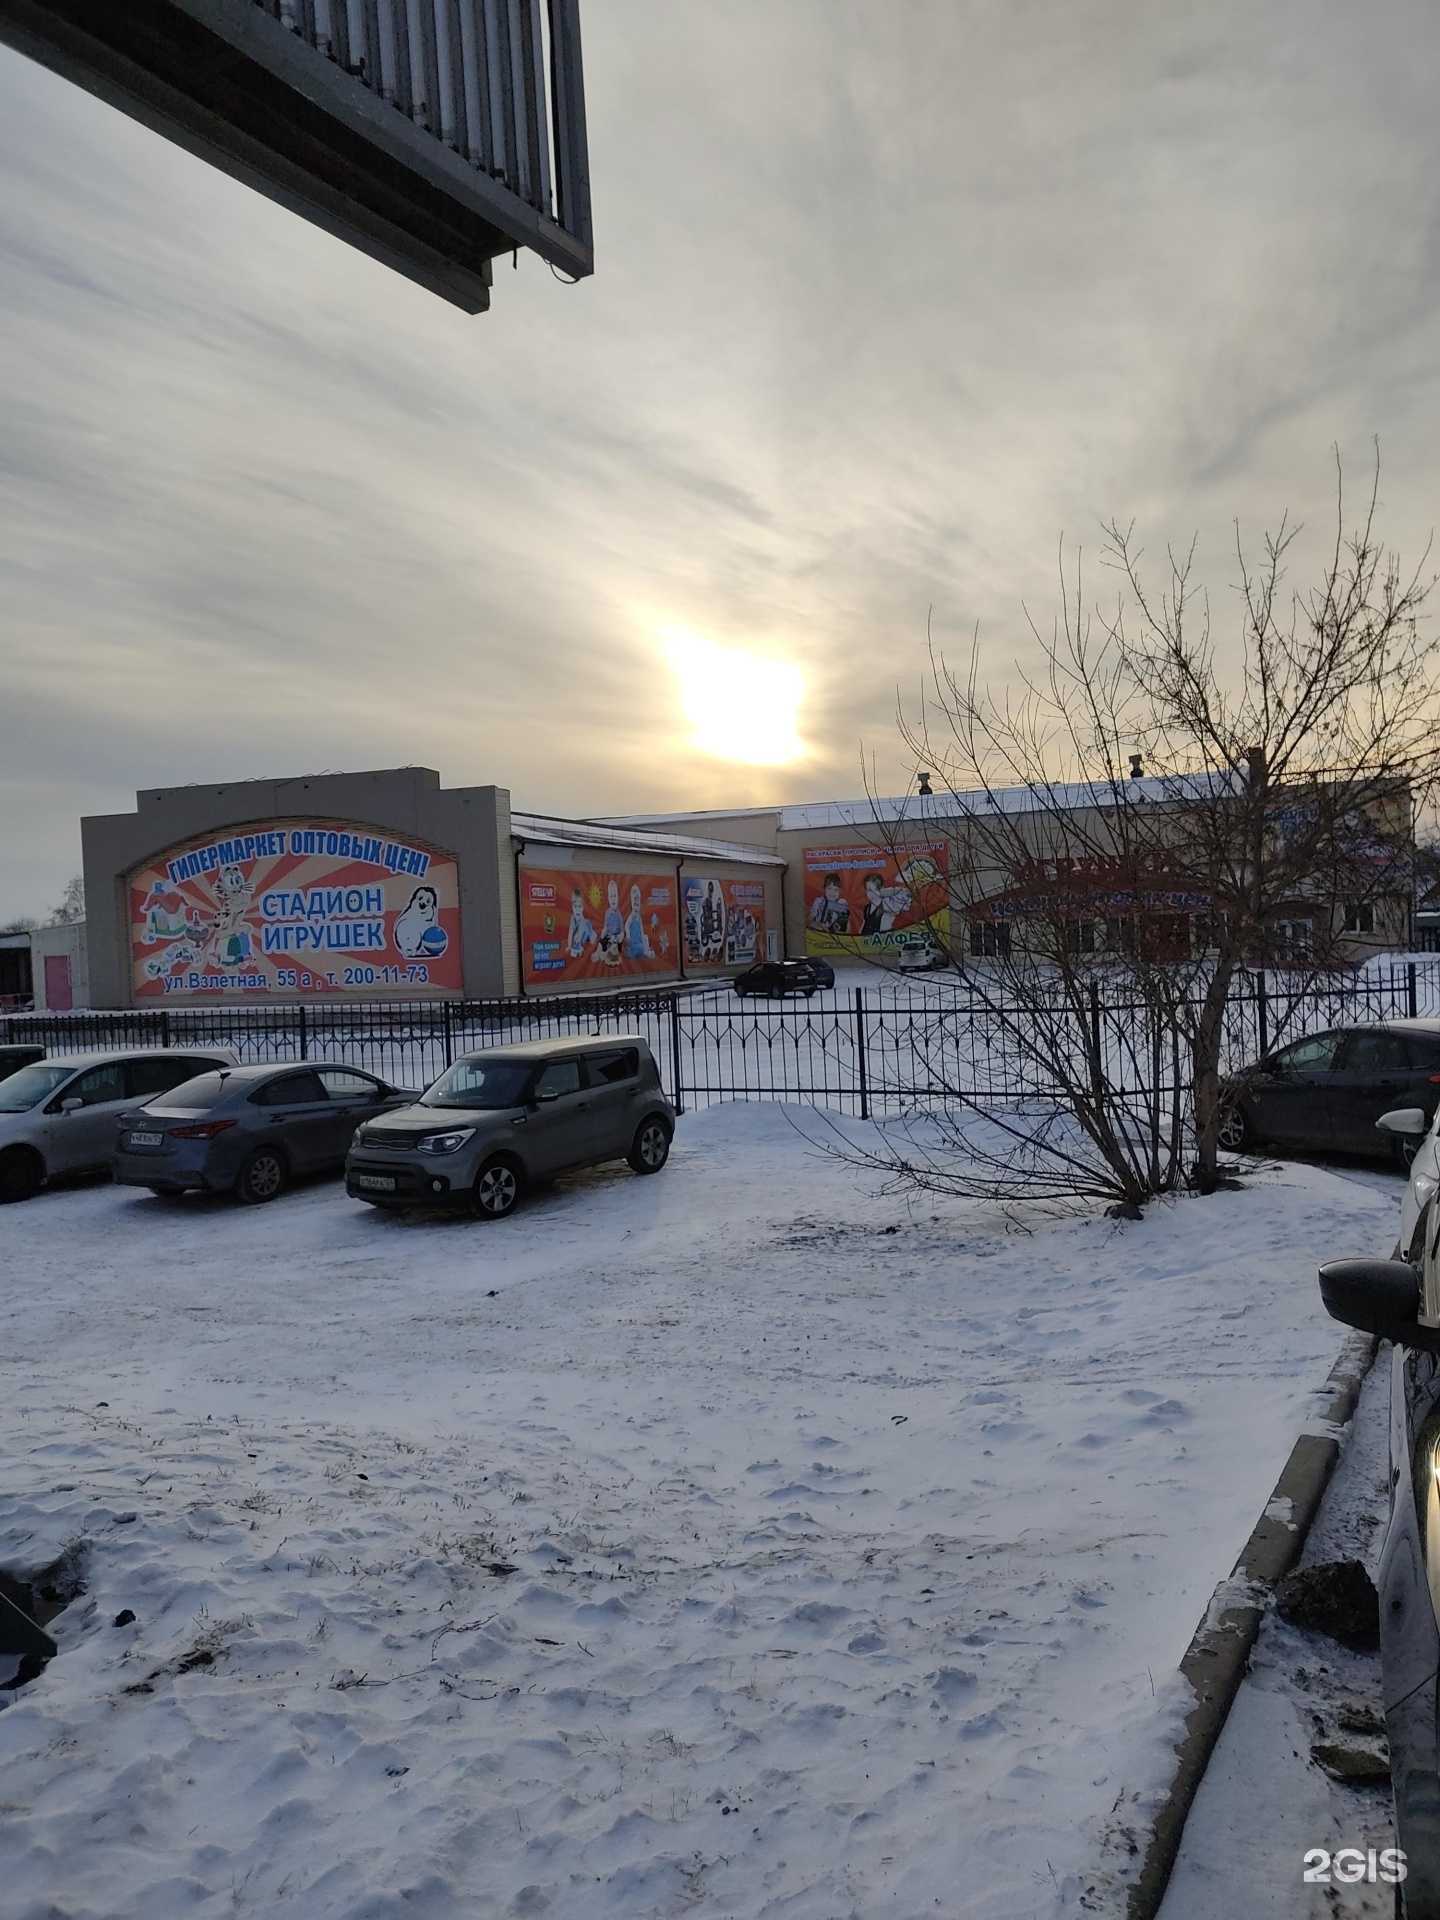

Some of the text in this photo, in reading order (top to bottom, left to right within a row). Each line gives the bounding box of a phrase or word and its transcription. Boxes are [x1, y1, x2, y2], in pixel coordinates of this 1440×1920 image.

[169, 831, 429, 882] ГИПЕРМАРКЕТ ОПТОВЫХ ЦЕН!
[263, 888, 382, 920] СТАДИОН
[264, 923, 383, 951] ИГРУШЕК
[277, 970, 296, 986] 55
[344, 967, 428, 985] 200-11-73
